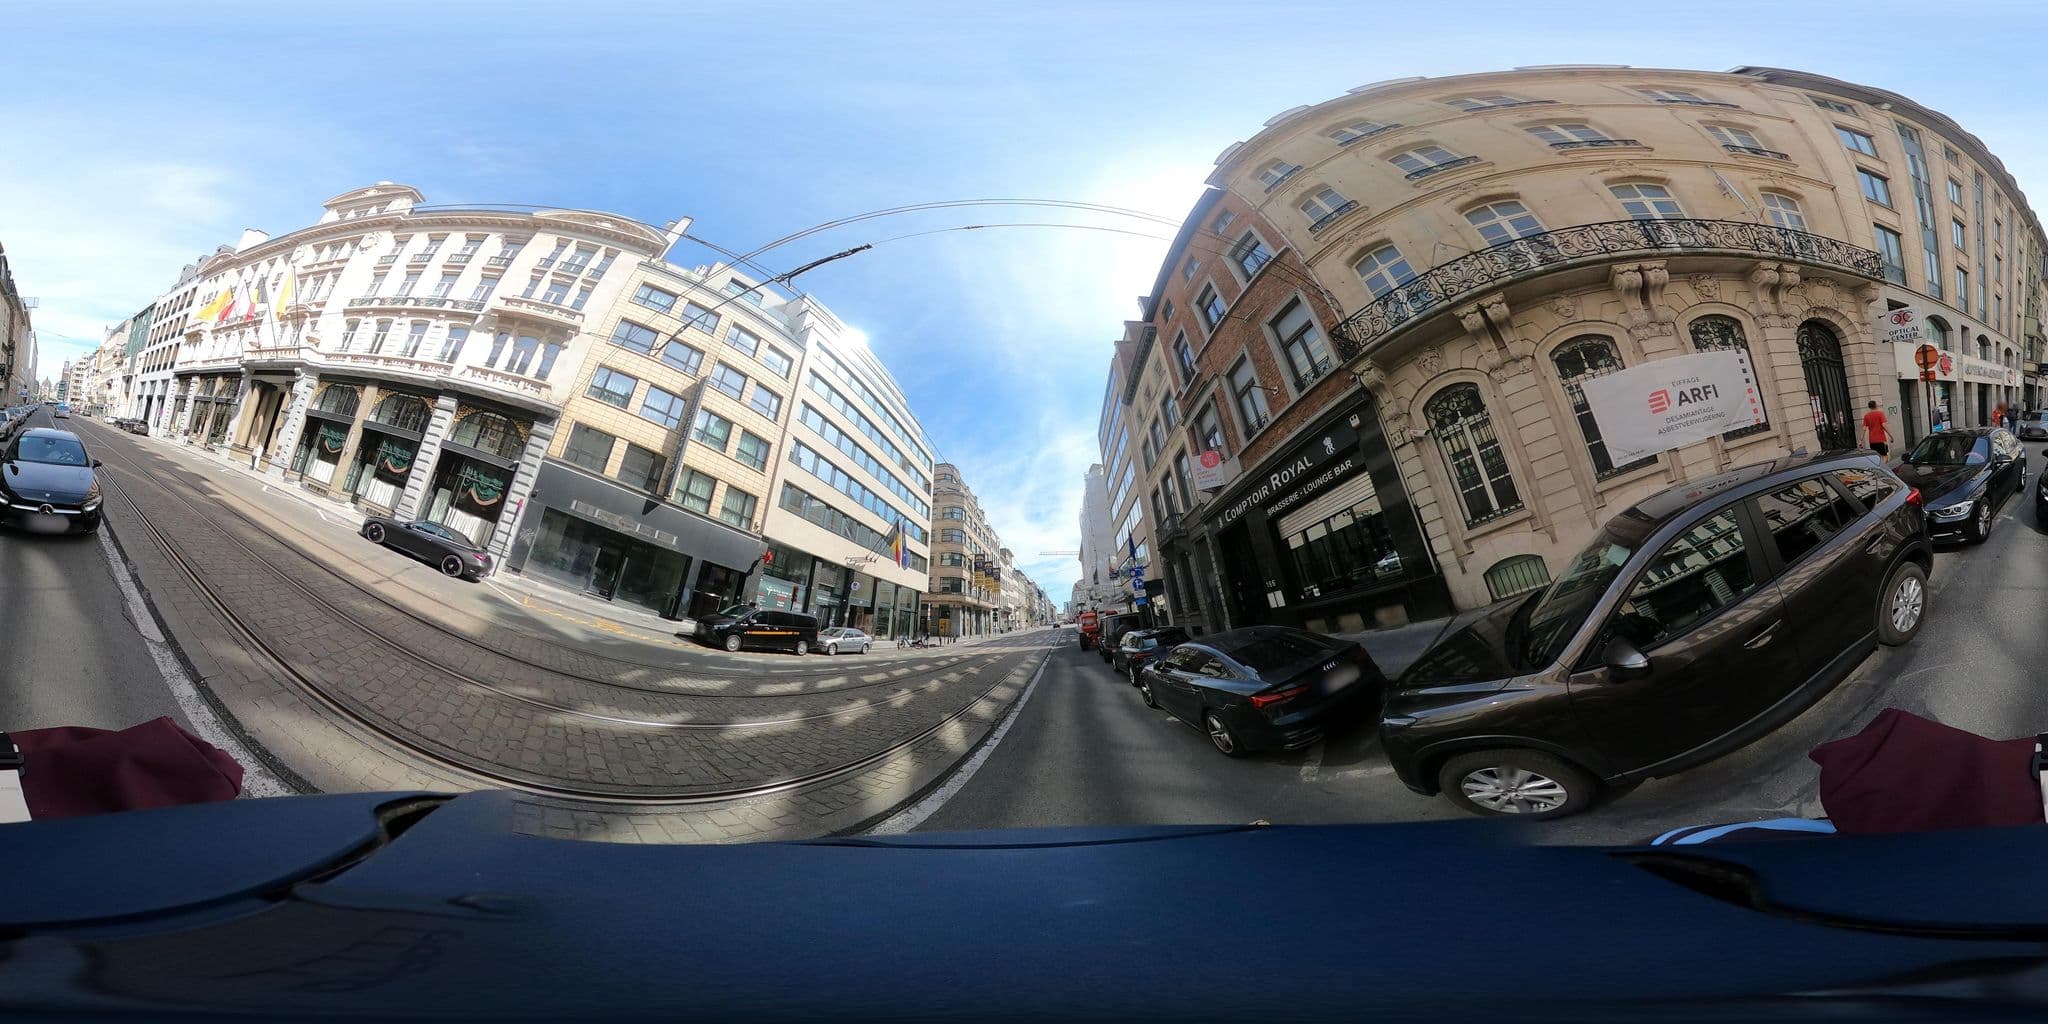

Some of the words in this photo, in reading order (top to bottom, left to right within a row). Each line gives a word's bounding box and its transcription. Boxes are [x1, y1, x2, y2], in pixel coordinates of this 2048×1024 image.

[1888, 325, 1920, 337] OPTICAL
[1891, 331, 1919, 342] CENTER
[1671, 376, 1701, 388] EIFFAGE
[1678, 383, 1719, 407] ARFI
[1665, 406, 1715, 424] DESAMIANTAGE
[1888, 406, 1898, 416] 170
[1224, 485, 1270, 522] COMPTOIR
[1269, 456, 1314, 491] ROYAL
[1267, 491, 1300, 517] BRASSERIE
[1303, 470, 1334, 497] LOUNGE
[1333, 459, 1353, 476] BAR
